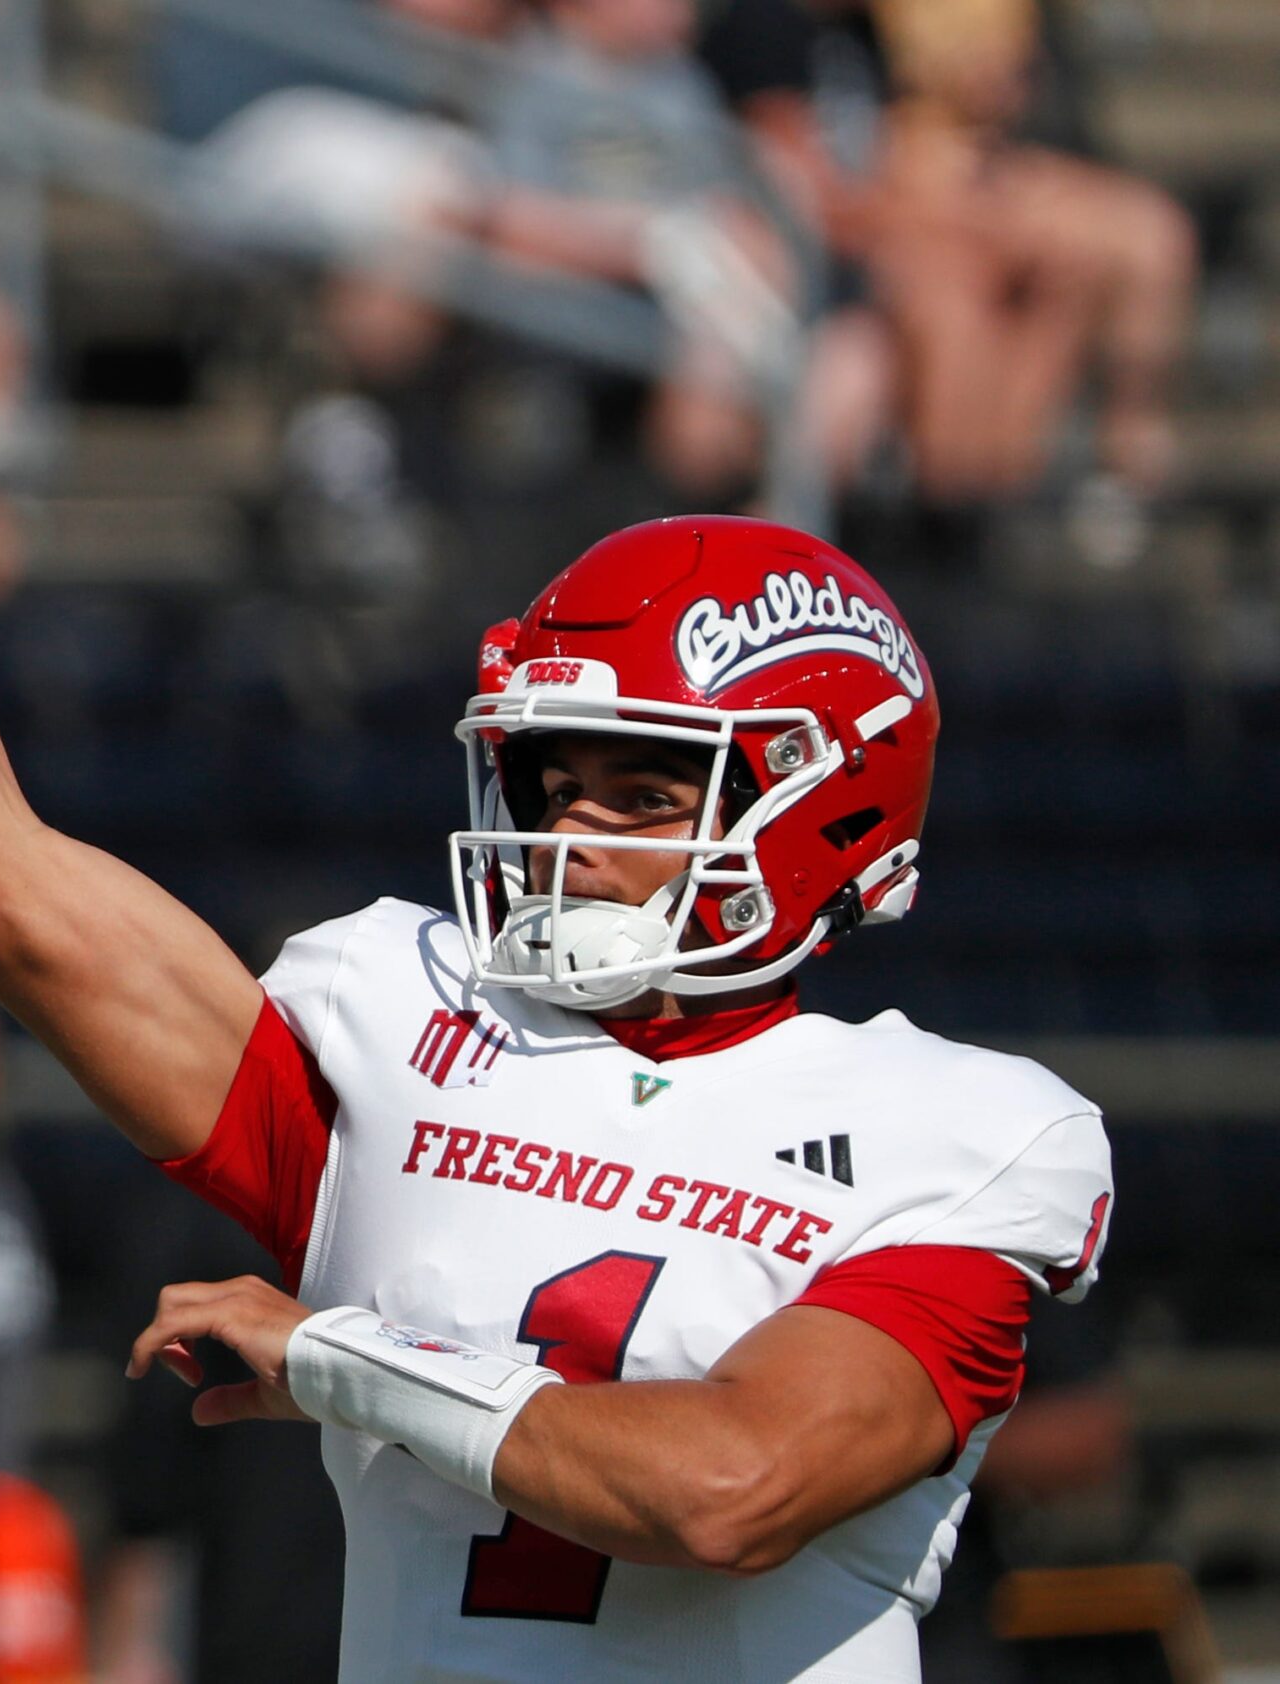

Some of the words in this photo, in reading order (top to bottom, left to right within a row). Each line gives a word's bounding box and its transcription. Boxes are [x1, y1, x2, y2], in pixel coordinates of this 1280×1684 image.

[675, 568, 926, 700] Bulldogs
[401, 1119, 634, 1213] FRESNO
[635, 1173, 835, 1265] STATE
